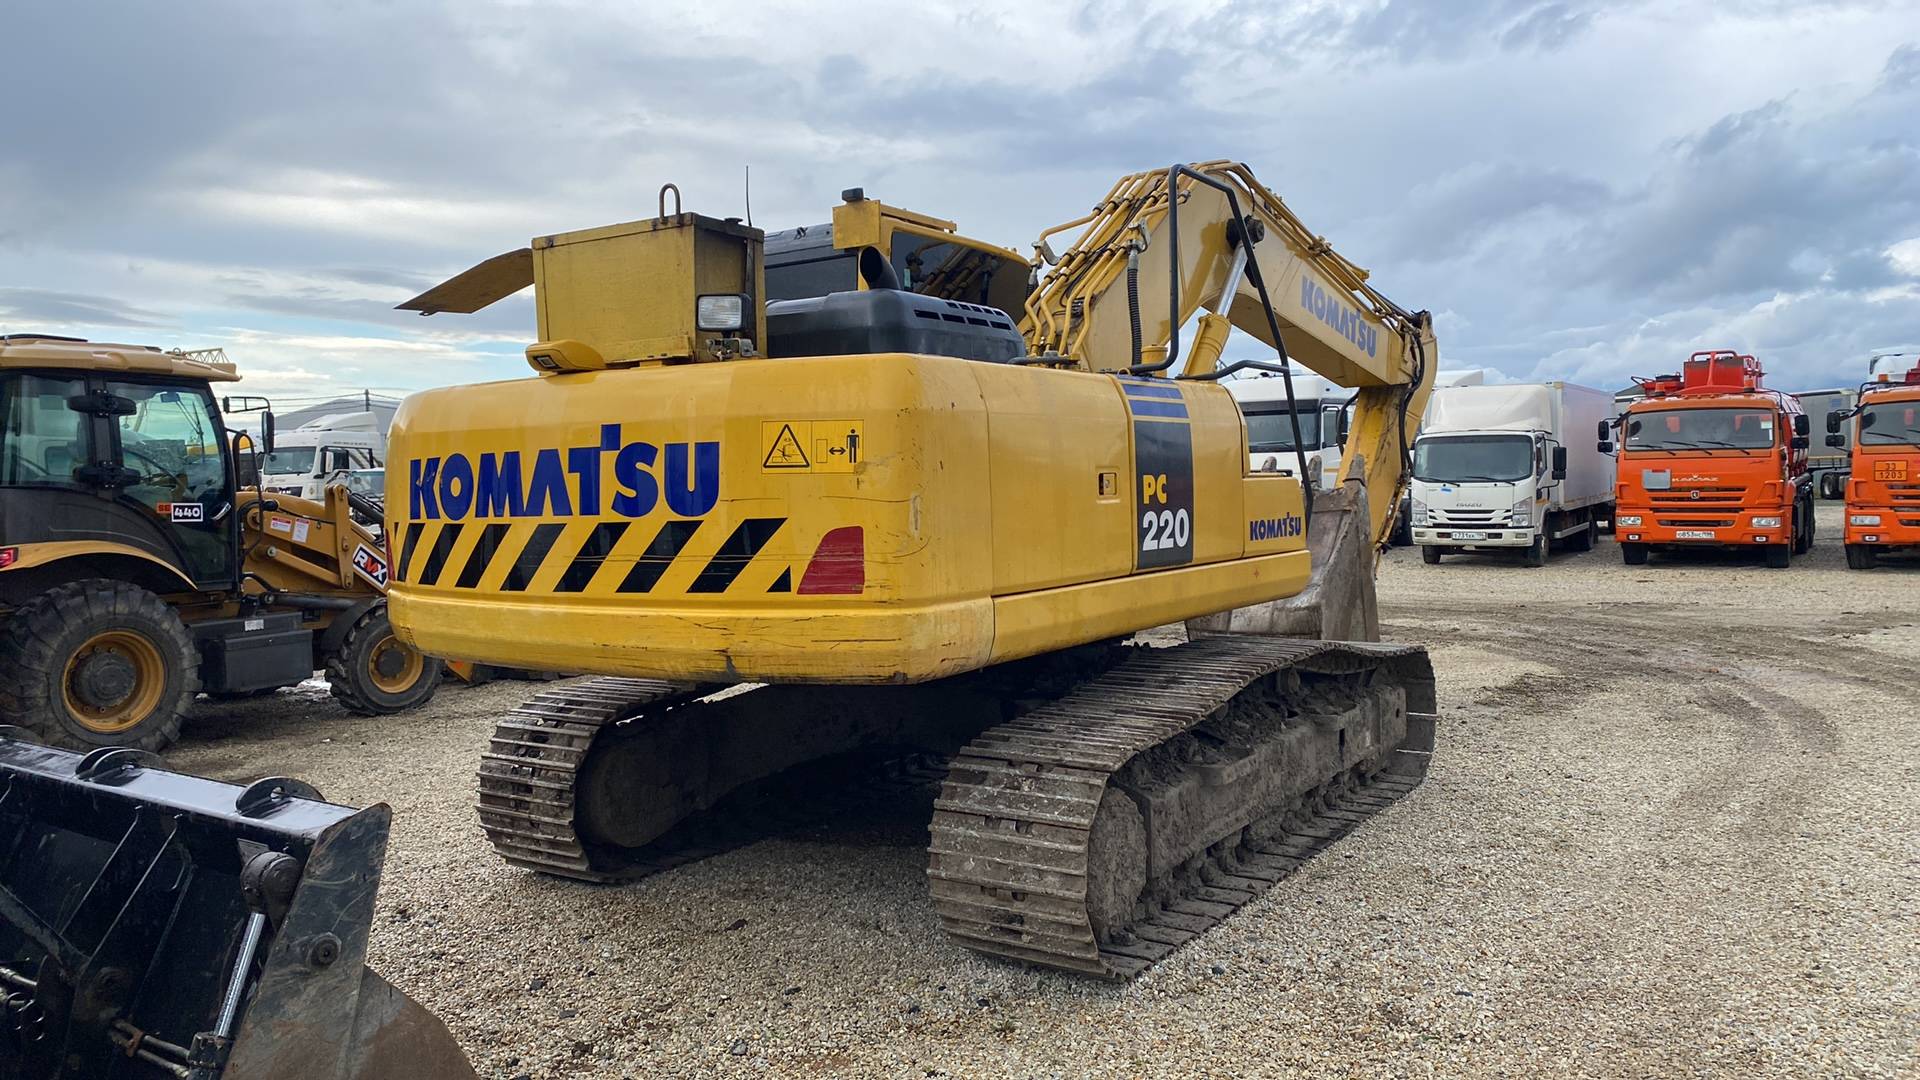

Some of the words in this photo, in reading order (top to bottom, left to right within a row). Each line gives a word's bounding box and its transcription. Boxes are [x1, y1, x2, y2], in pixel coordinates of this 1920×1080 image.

[1301, 275, 1376, 358] KOMATSU
[409, 423, 720, 521] KOMATSU
[1143, 474, 1167, 504] PC
[174, 507, 201, 517] 440
[1250, 511, 1301, 541] KOMATSU
[1142, 508, 1190, 551] 220
[354, 550, 386, 581] RMX
